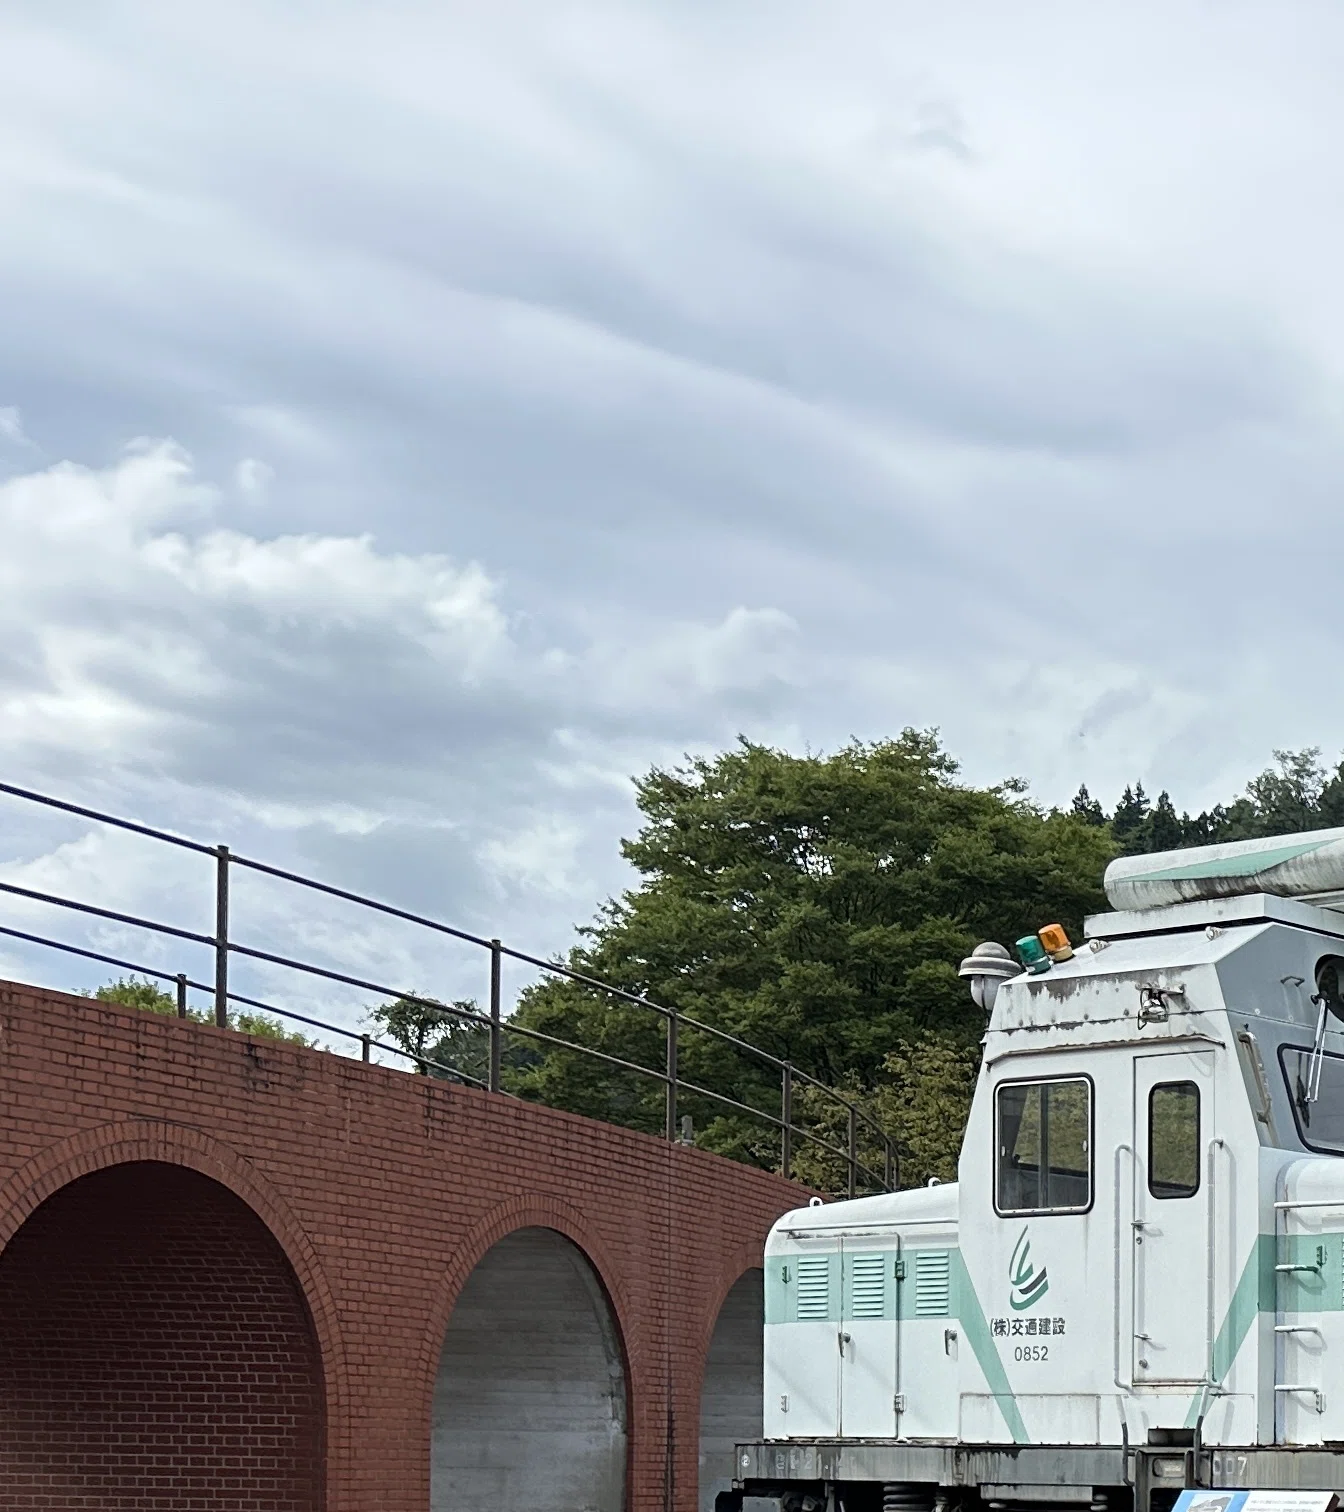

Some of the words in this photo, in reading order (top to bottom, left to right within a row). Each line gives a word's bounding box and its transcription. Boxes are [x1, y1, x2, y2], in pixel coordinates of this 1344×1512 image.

[990, 1317, 1066, 1337] (株)交通建設
[1014, 1345, 1049, 1362] 0852
